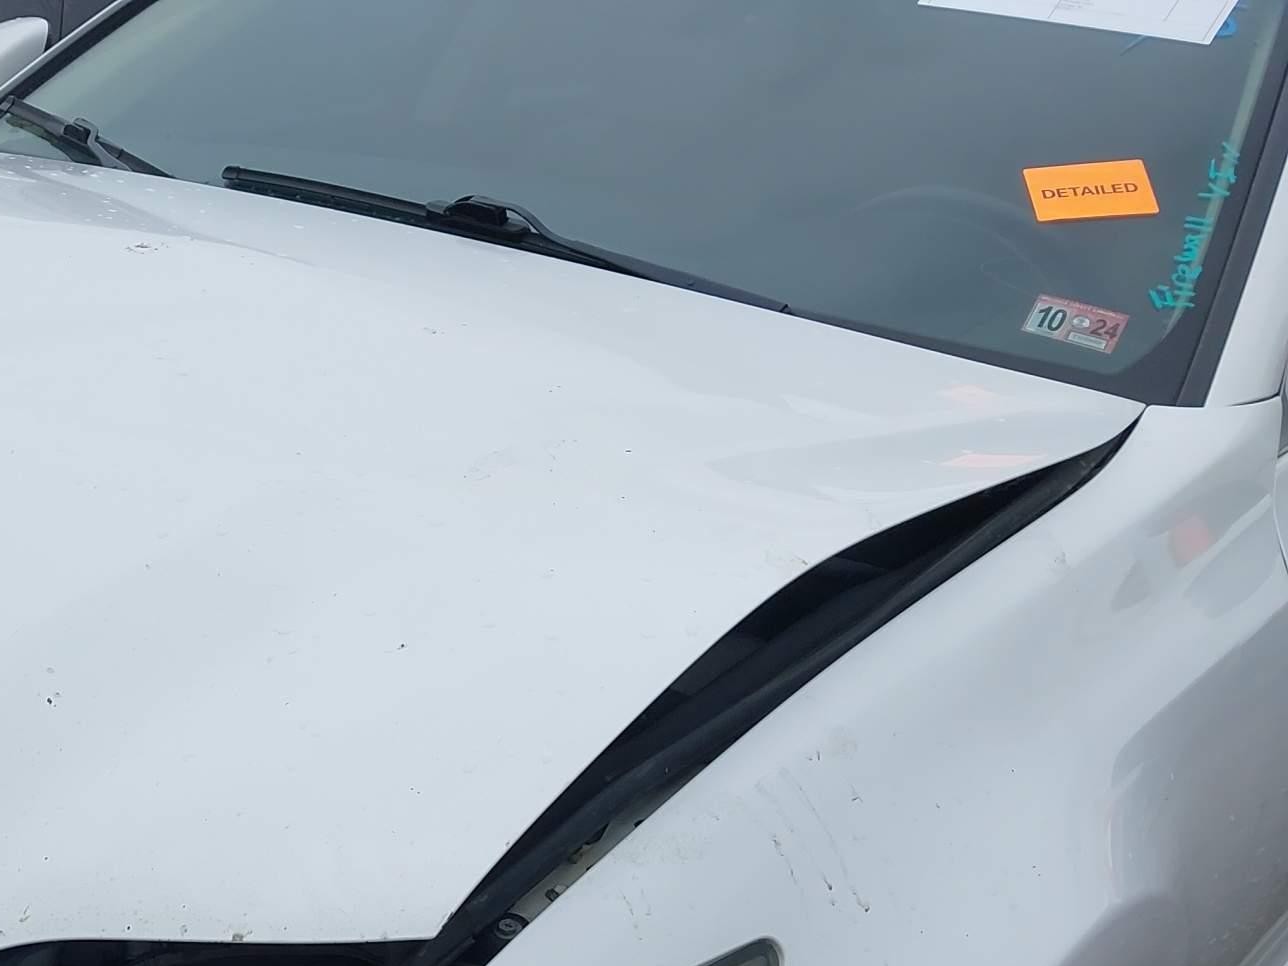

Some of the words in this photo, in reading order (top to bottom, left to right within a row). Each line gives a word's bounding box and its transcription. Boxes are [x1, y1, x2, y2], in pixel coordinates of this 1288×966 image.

[1041, 181, 1139, 201] DETAILED
[1036, 305, 1068, 332] 10
[1089, 318, 1120, 340] 24
